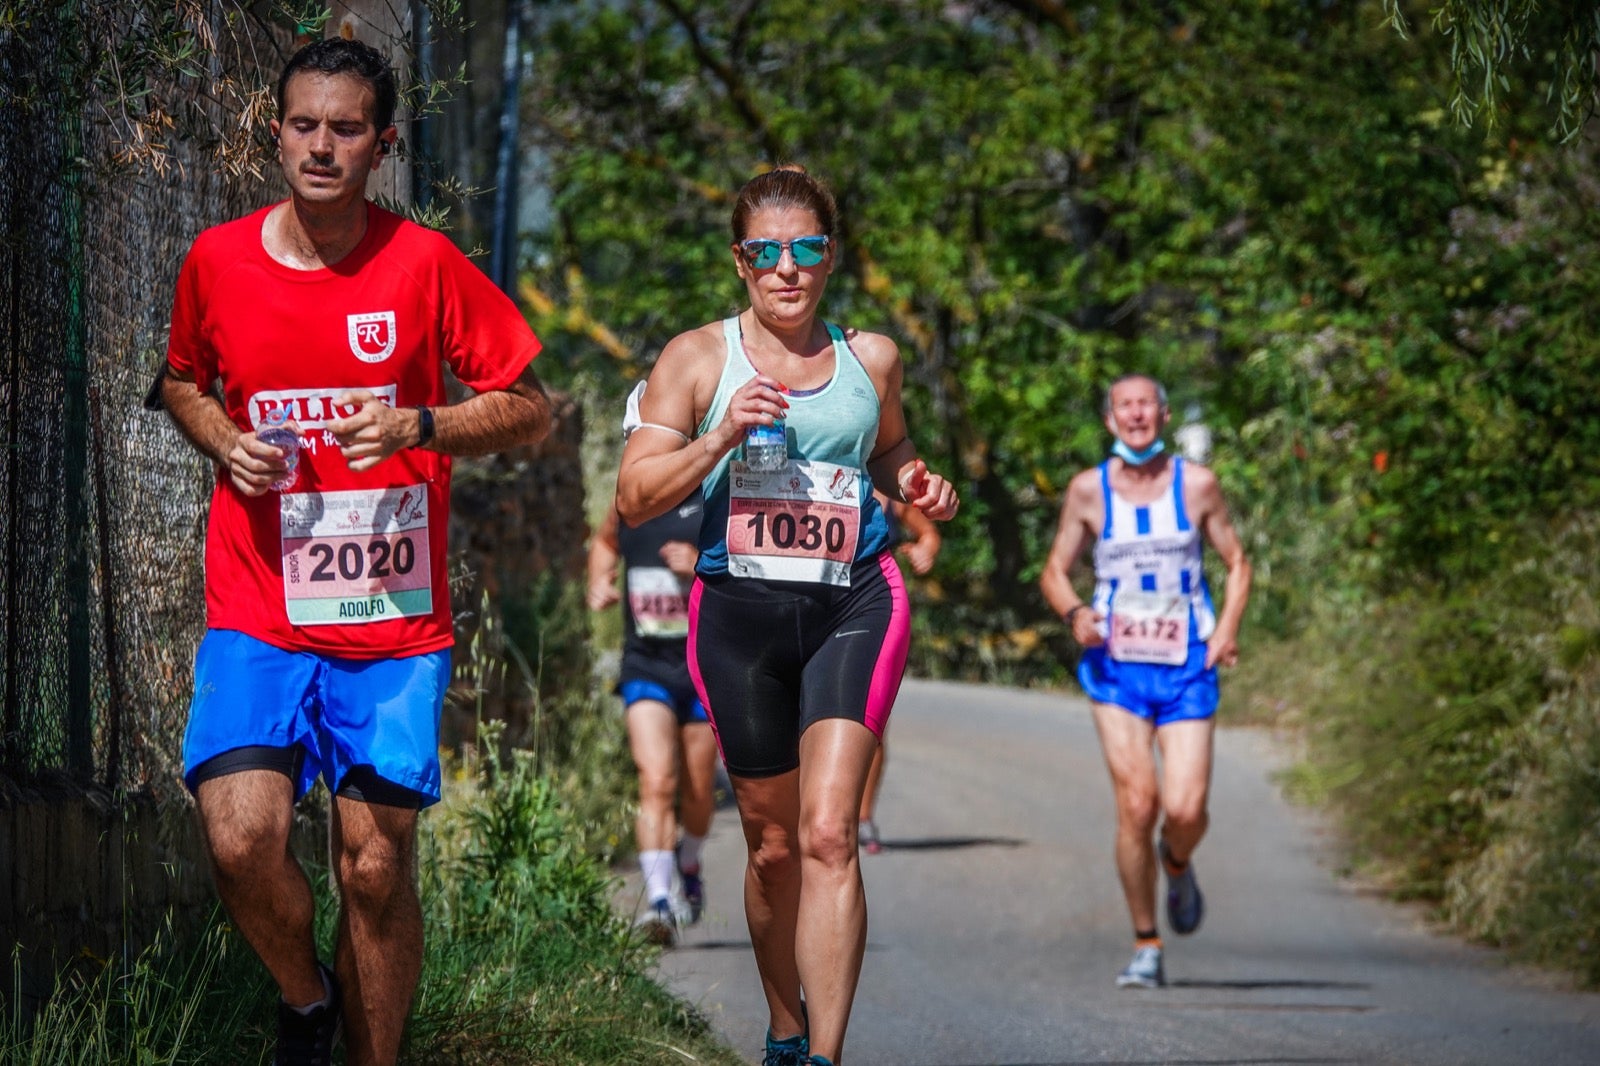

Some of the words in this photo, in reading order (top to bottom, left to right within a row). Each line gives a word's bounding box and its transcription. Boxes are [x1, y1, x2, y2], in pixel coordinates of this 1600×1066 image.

[350, 325, 362, 357] COLEGIO
[385, 321, 395, 356] ROSALES
[358, 324, 387, 347] R
[747, 511, 846, 553] 1030
[289, 554, 300, 584] SENIOR
[308, 537, 415, 582] 2020
[339, 599, 385, 617] ADOLFO
[1121, 617, 1179, 640] 2172
